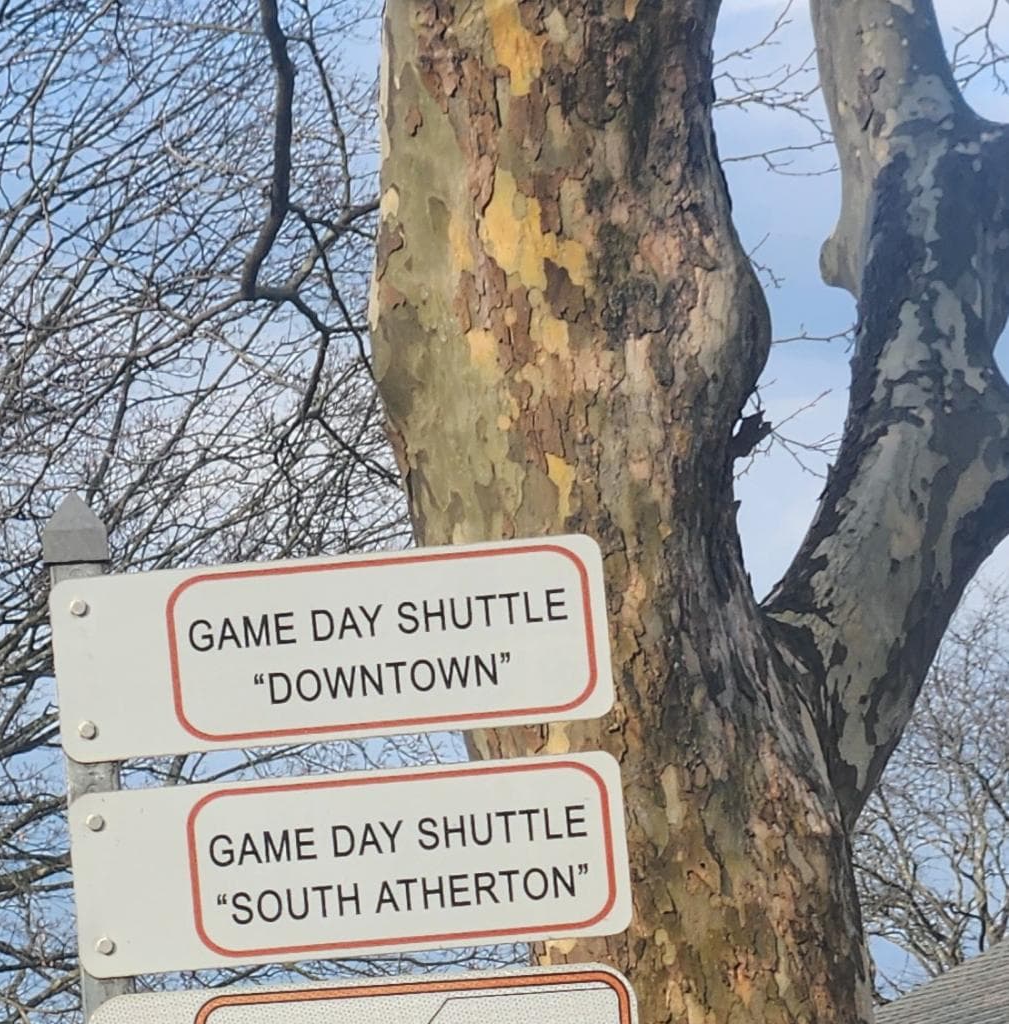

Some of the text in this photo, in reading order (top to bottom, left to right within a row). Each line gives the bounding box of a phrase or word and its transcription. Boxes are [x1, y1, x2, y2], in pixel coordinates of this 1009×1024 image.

[189, 588, 568, 653] GAME DAY SHUTTLE
[253, 651, 511, 705] “DOWNTOWN”
[208, 805, 588, 867] GAME DAY SHUTTLE
[217, 864, 589, 925] “SOUTH ATHERTON”
